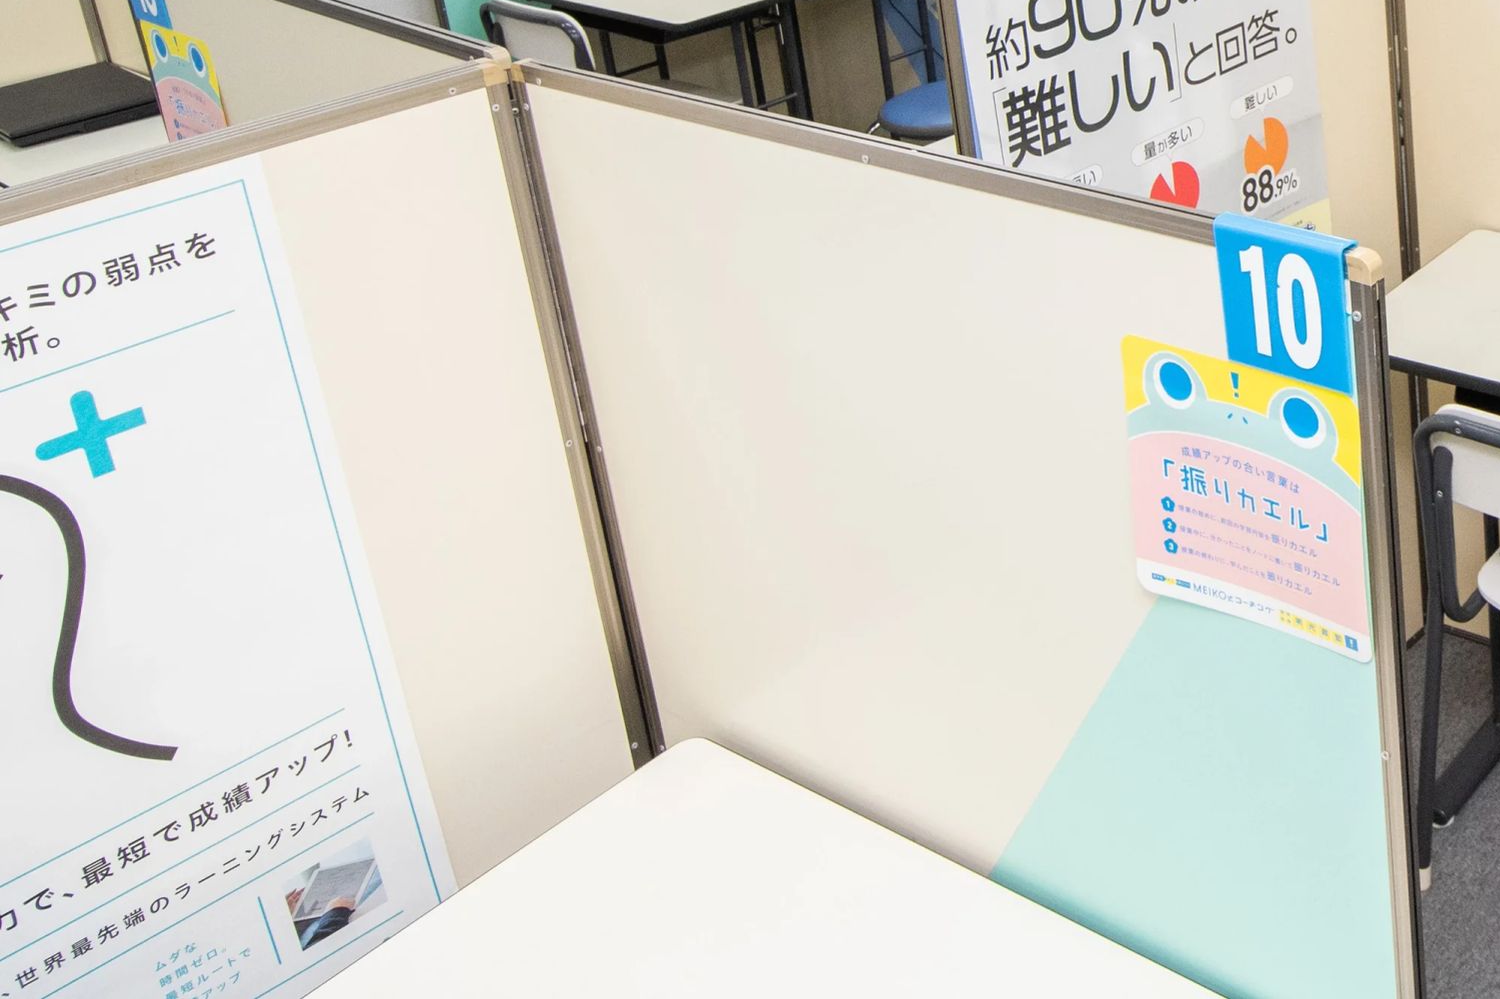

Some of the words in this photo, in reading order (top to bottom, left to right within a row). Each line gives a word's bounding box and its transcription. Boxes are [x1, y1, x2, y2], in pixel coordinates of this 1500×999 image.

[992, 9, 1298, 168] 「難しい」と回答。
[1244, 85, 1278, 112] 難しい
[1143, 125, 1193, 160] 量が多い
[1242, 169, 1298, 212] 88.9%
[1238, 244, 1323, 370] 10
[1162, 458, 1328, 542] 「振りカエル」
[155, 942, 197, 972] ムダな
[160, 948, 226, 987] 時間ゼロ。
